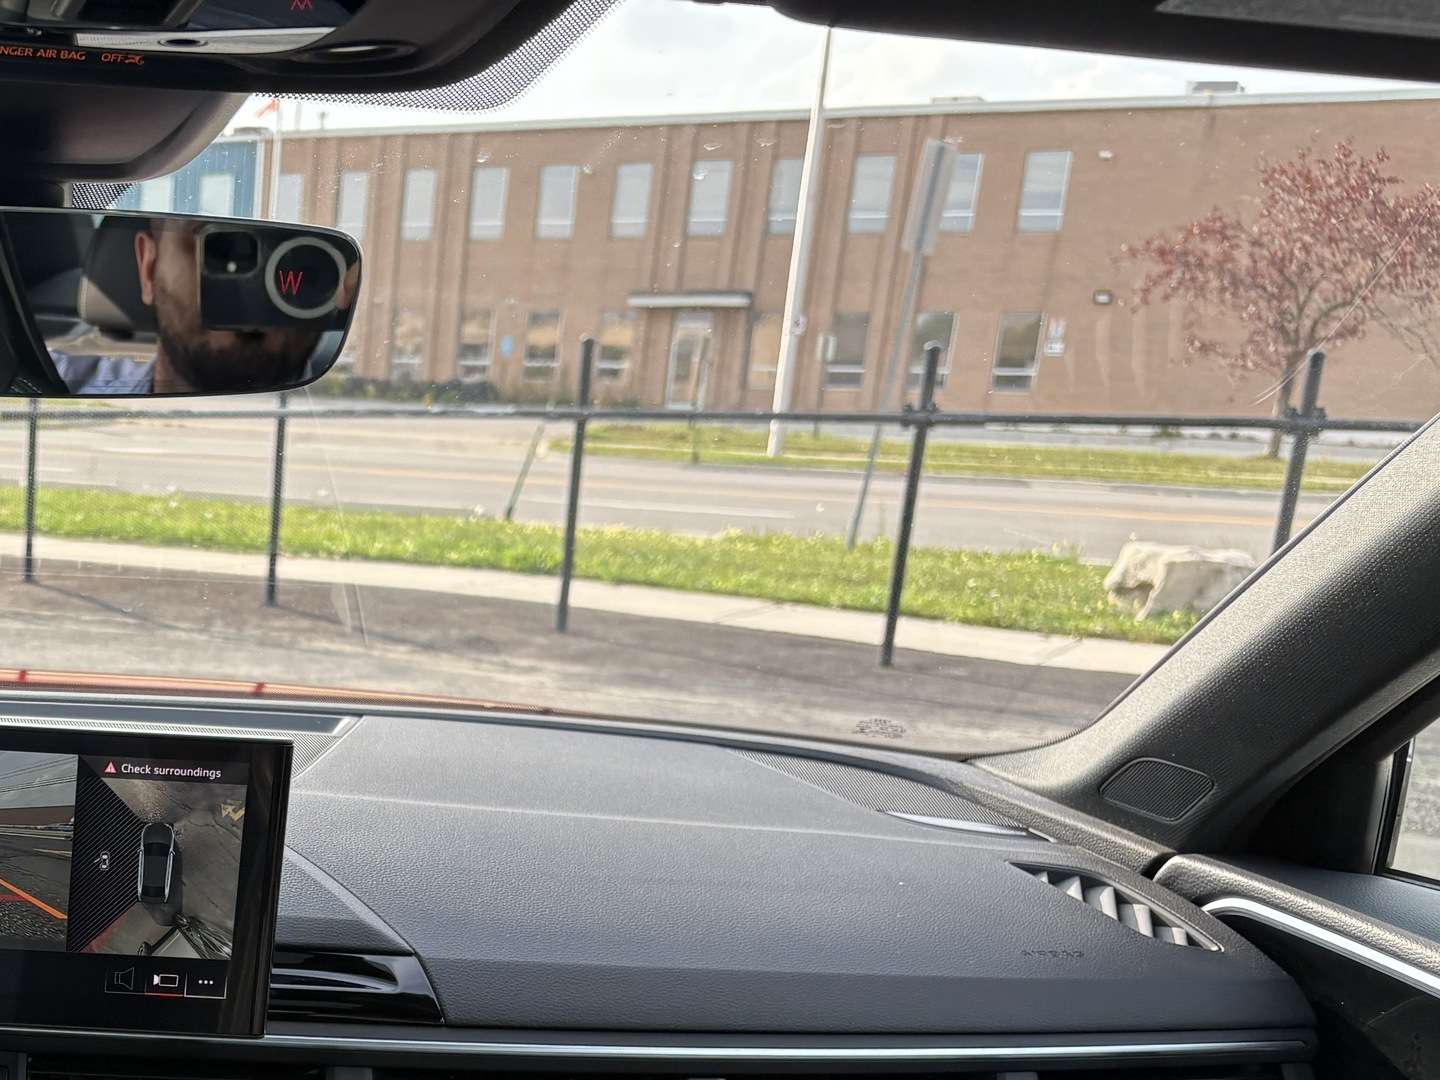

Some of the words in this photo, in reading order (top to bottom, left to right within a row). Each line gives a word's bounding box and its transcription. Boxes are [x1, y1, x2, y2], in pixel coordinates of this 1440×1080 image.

[36, 48, 57, 58] AIR
[60, 50, 86, 60] BAG
[101, 52, 125, 63] OFF
[279, 270, 304, 296] W
[121, 763, 151, 775] Check
[154, 765, 222, 779] surroundings
